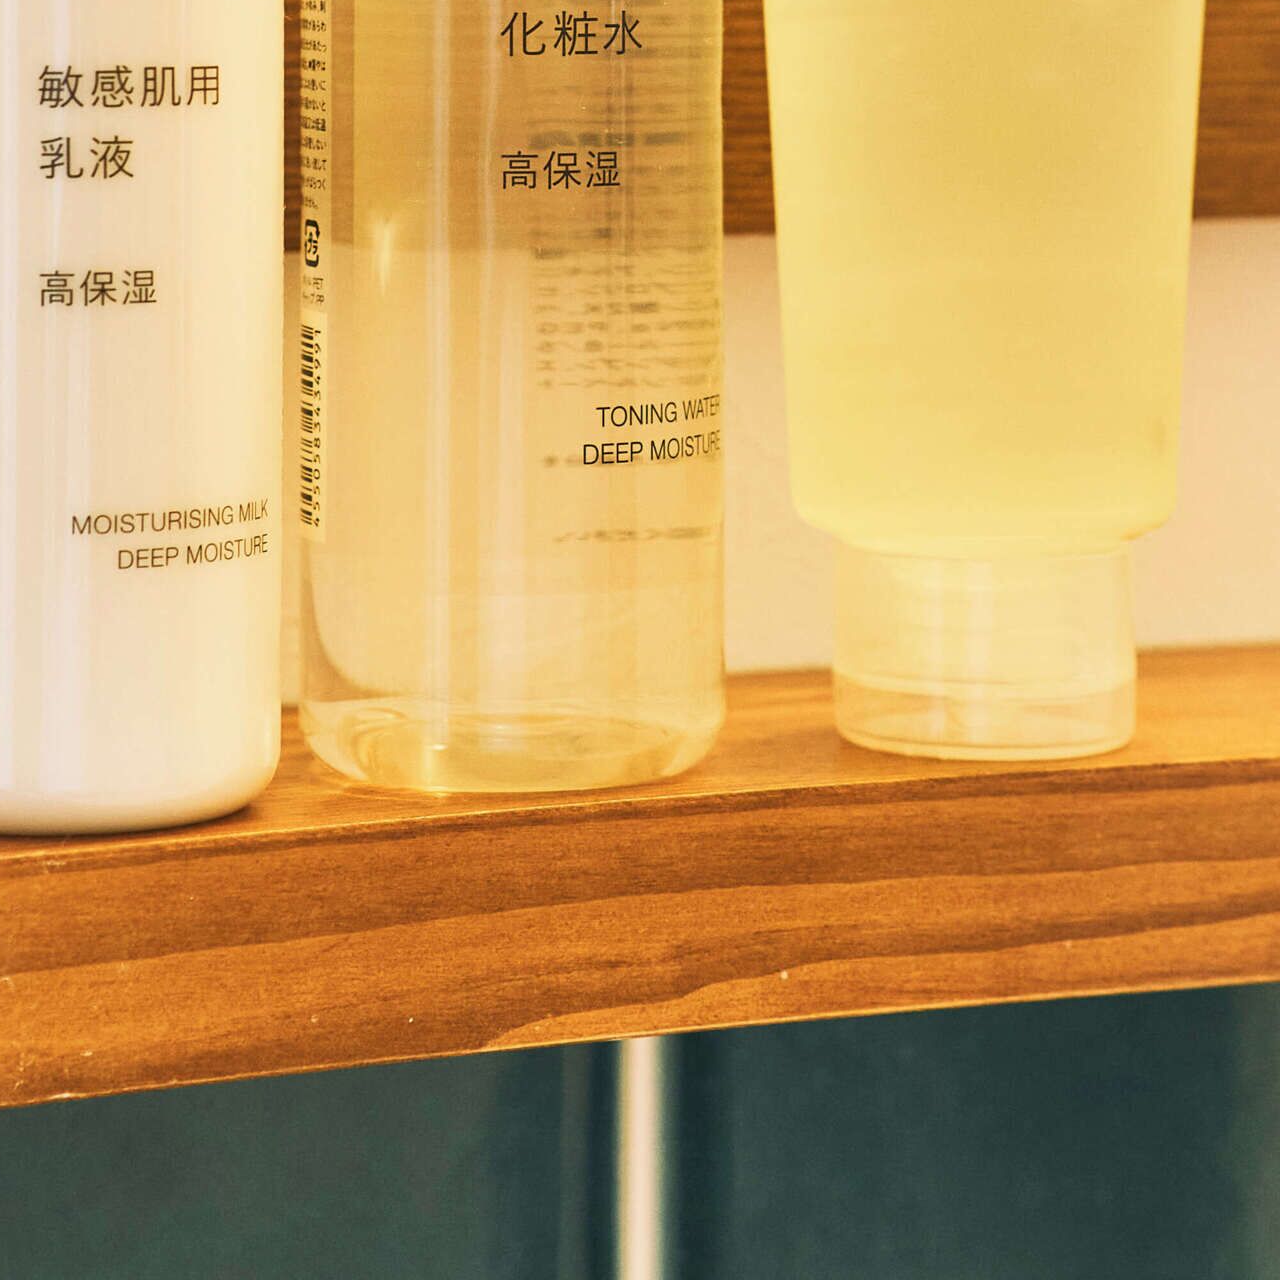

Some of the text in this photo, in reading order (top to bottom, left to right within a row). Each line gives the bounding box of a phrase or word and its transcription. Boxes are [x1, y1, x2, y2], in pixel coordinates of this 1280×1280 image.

[499, 10, 644, 57] 化粧水
[37, 64, 220, 109] 敏感肌用
[39, 136, 134, 180] 乳液
[500, 150, 621, 190] 高保湿
[38, 269, 158, 308] 高保湿
[595, 400, 678, 428] TONING
[582, 440, 644, 466] DEEP
[71, 498, 269, 536] MOISTURISING MILK
[117, 532, 269, 570] DEEP MOISTURE
